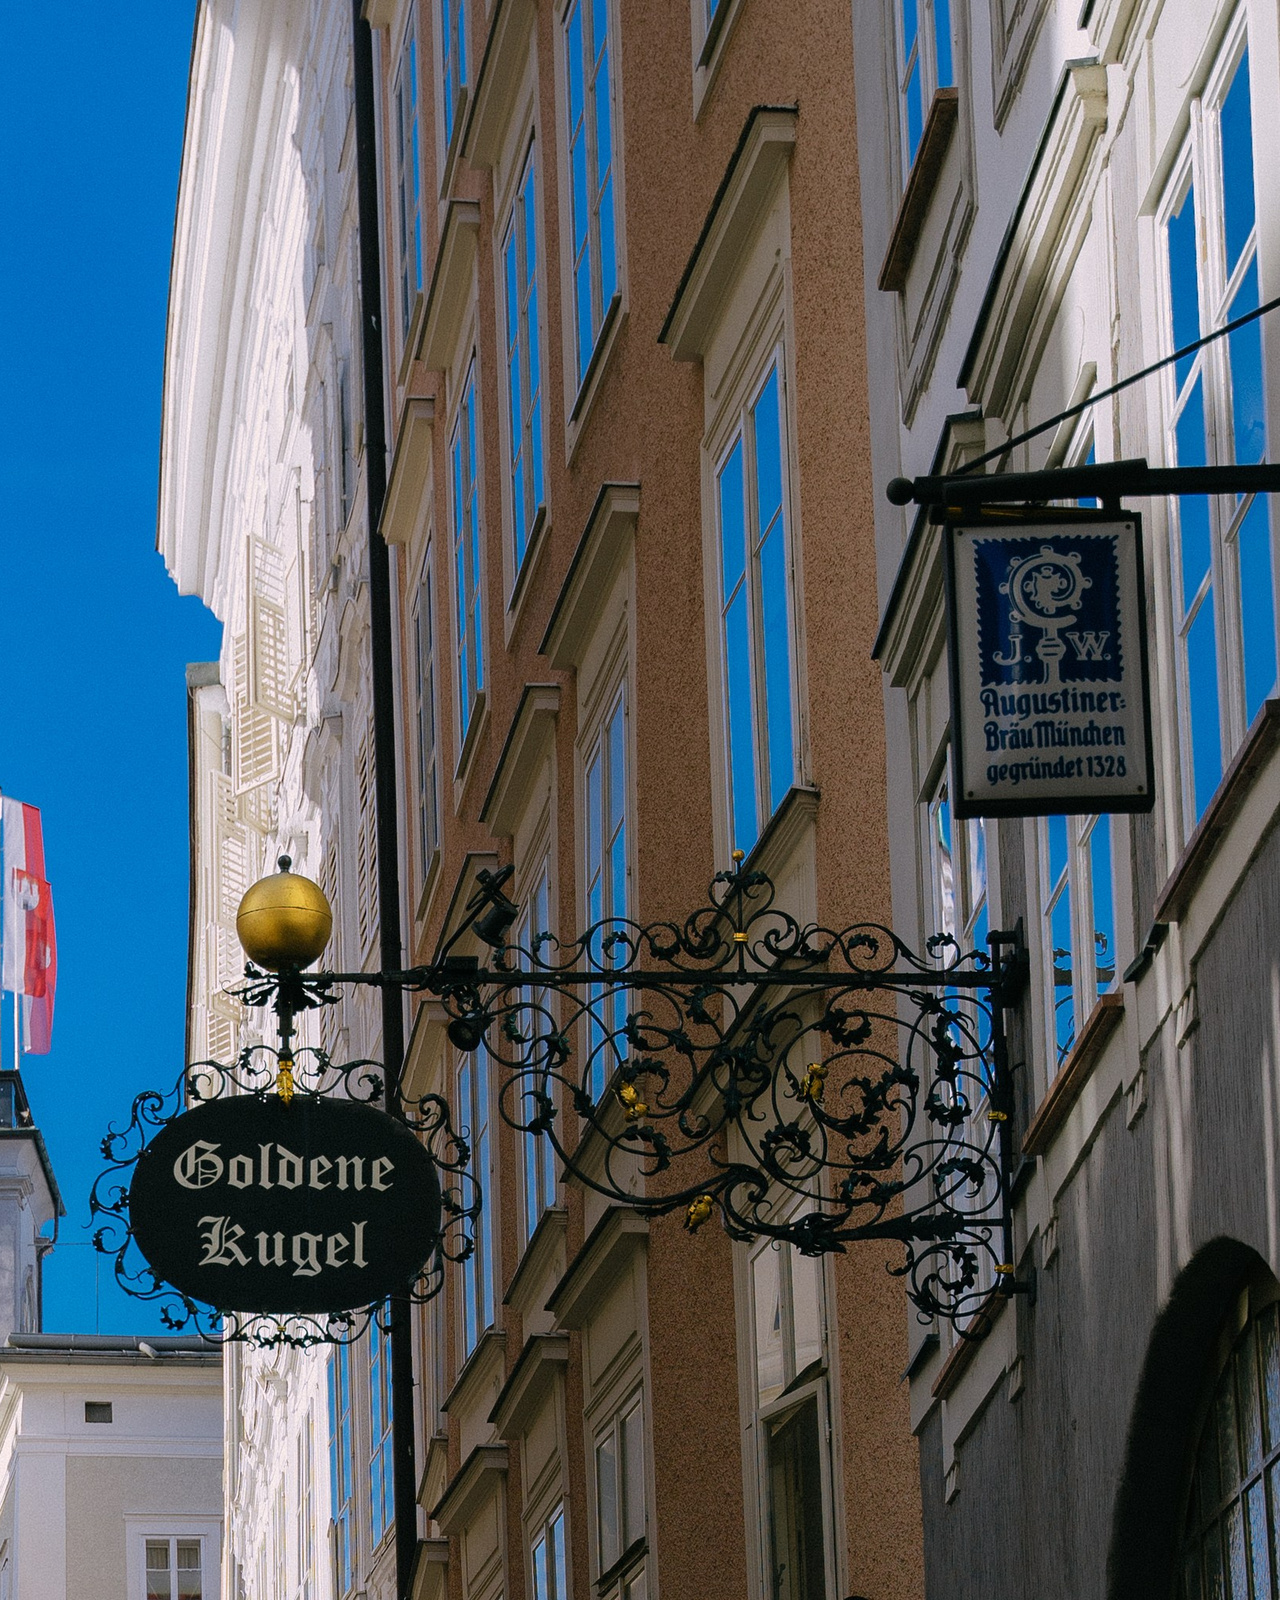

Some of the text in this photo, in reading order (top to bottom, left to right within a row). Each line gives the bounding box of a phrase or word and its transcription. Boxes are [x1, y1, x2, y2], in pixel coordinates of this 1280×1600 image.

[987, 755, 1127, 786] gegründet 1328
[173, 1139, 395, 1191] Goldene
[197, 1216, 369, 1277] Kugel
